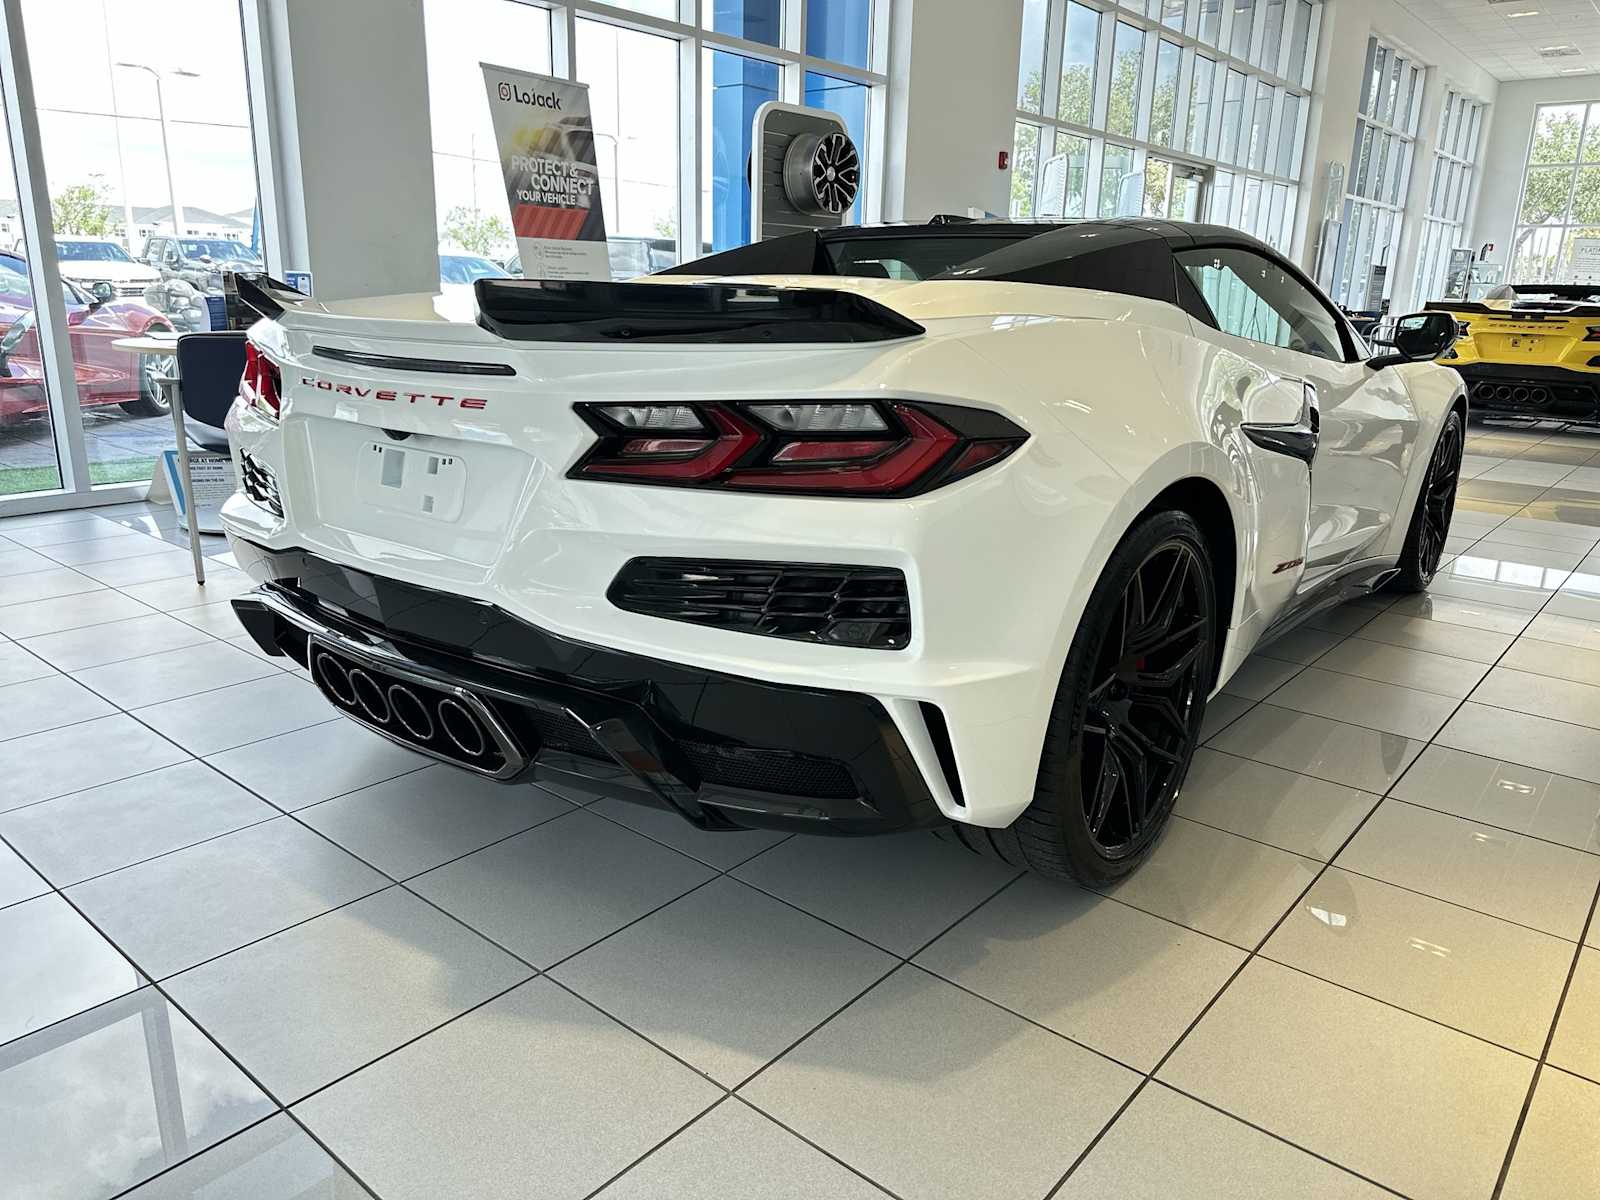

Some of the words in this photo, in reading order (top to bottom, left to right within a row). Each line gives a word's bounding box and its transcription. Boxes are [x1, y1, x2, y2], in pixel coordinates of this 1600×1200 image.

[511, 155, 569, 177] PROTECT
[569, 163, 579, 177] &
[531, 174, 594, 196] CONNECT
[516, 190, 541, 202] YOUR
[541, 193, 576, 206] VEHICLE
[301, 377, 488, 410] CORVETTE
